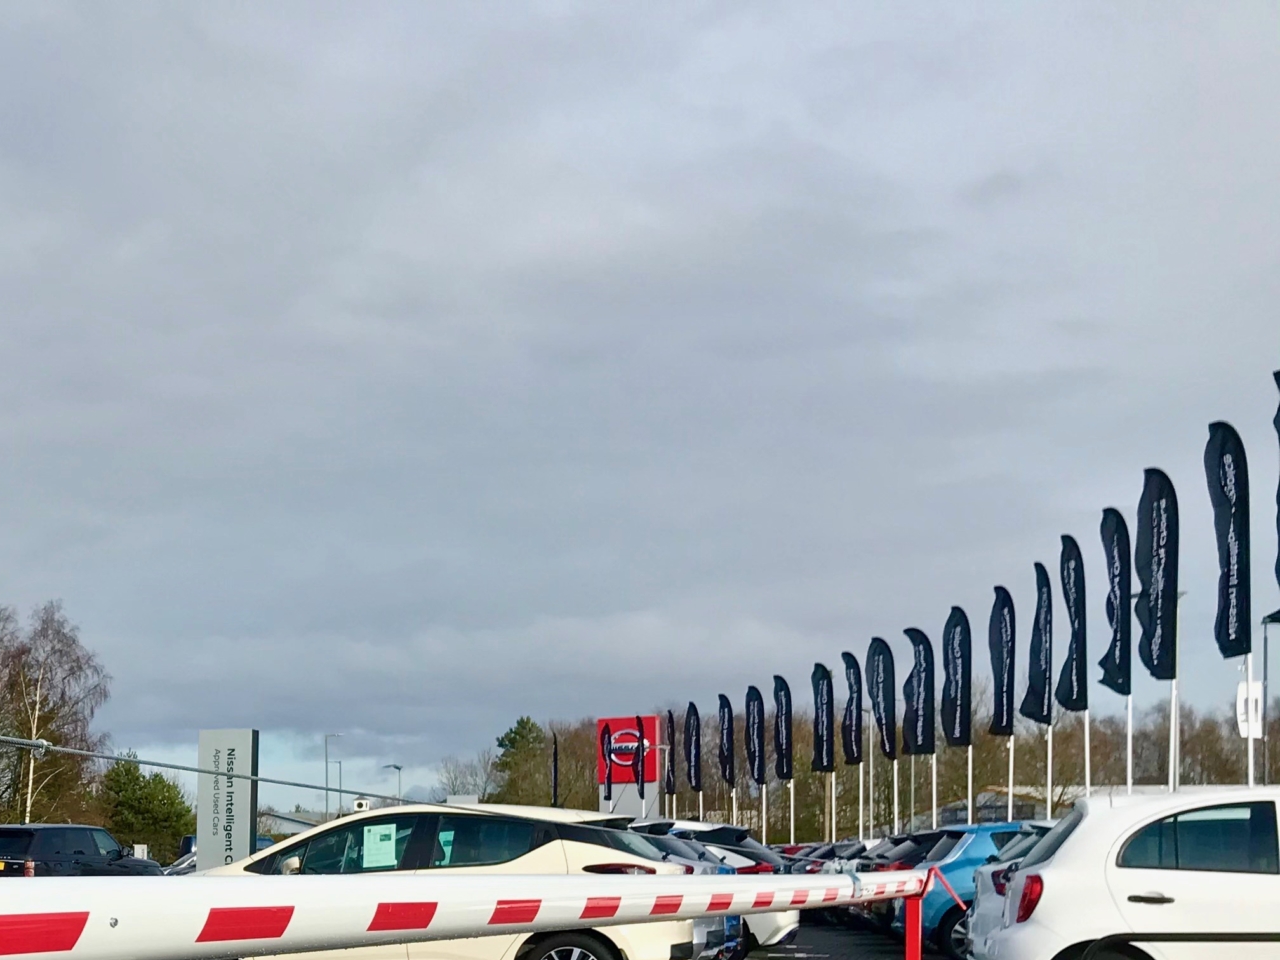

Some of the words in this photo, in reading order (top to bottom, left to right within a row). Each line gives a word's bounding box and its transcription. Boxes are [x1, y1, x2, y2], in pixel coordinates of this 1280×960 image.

[212, 748, 221, 791] Apprved
[226, 748, 236, 789] Nissan
[212, 792, 220, 815] Used
[223, 791, 235, 852] Intelligent
[212, 816, 220, 836] Cars
